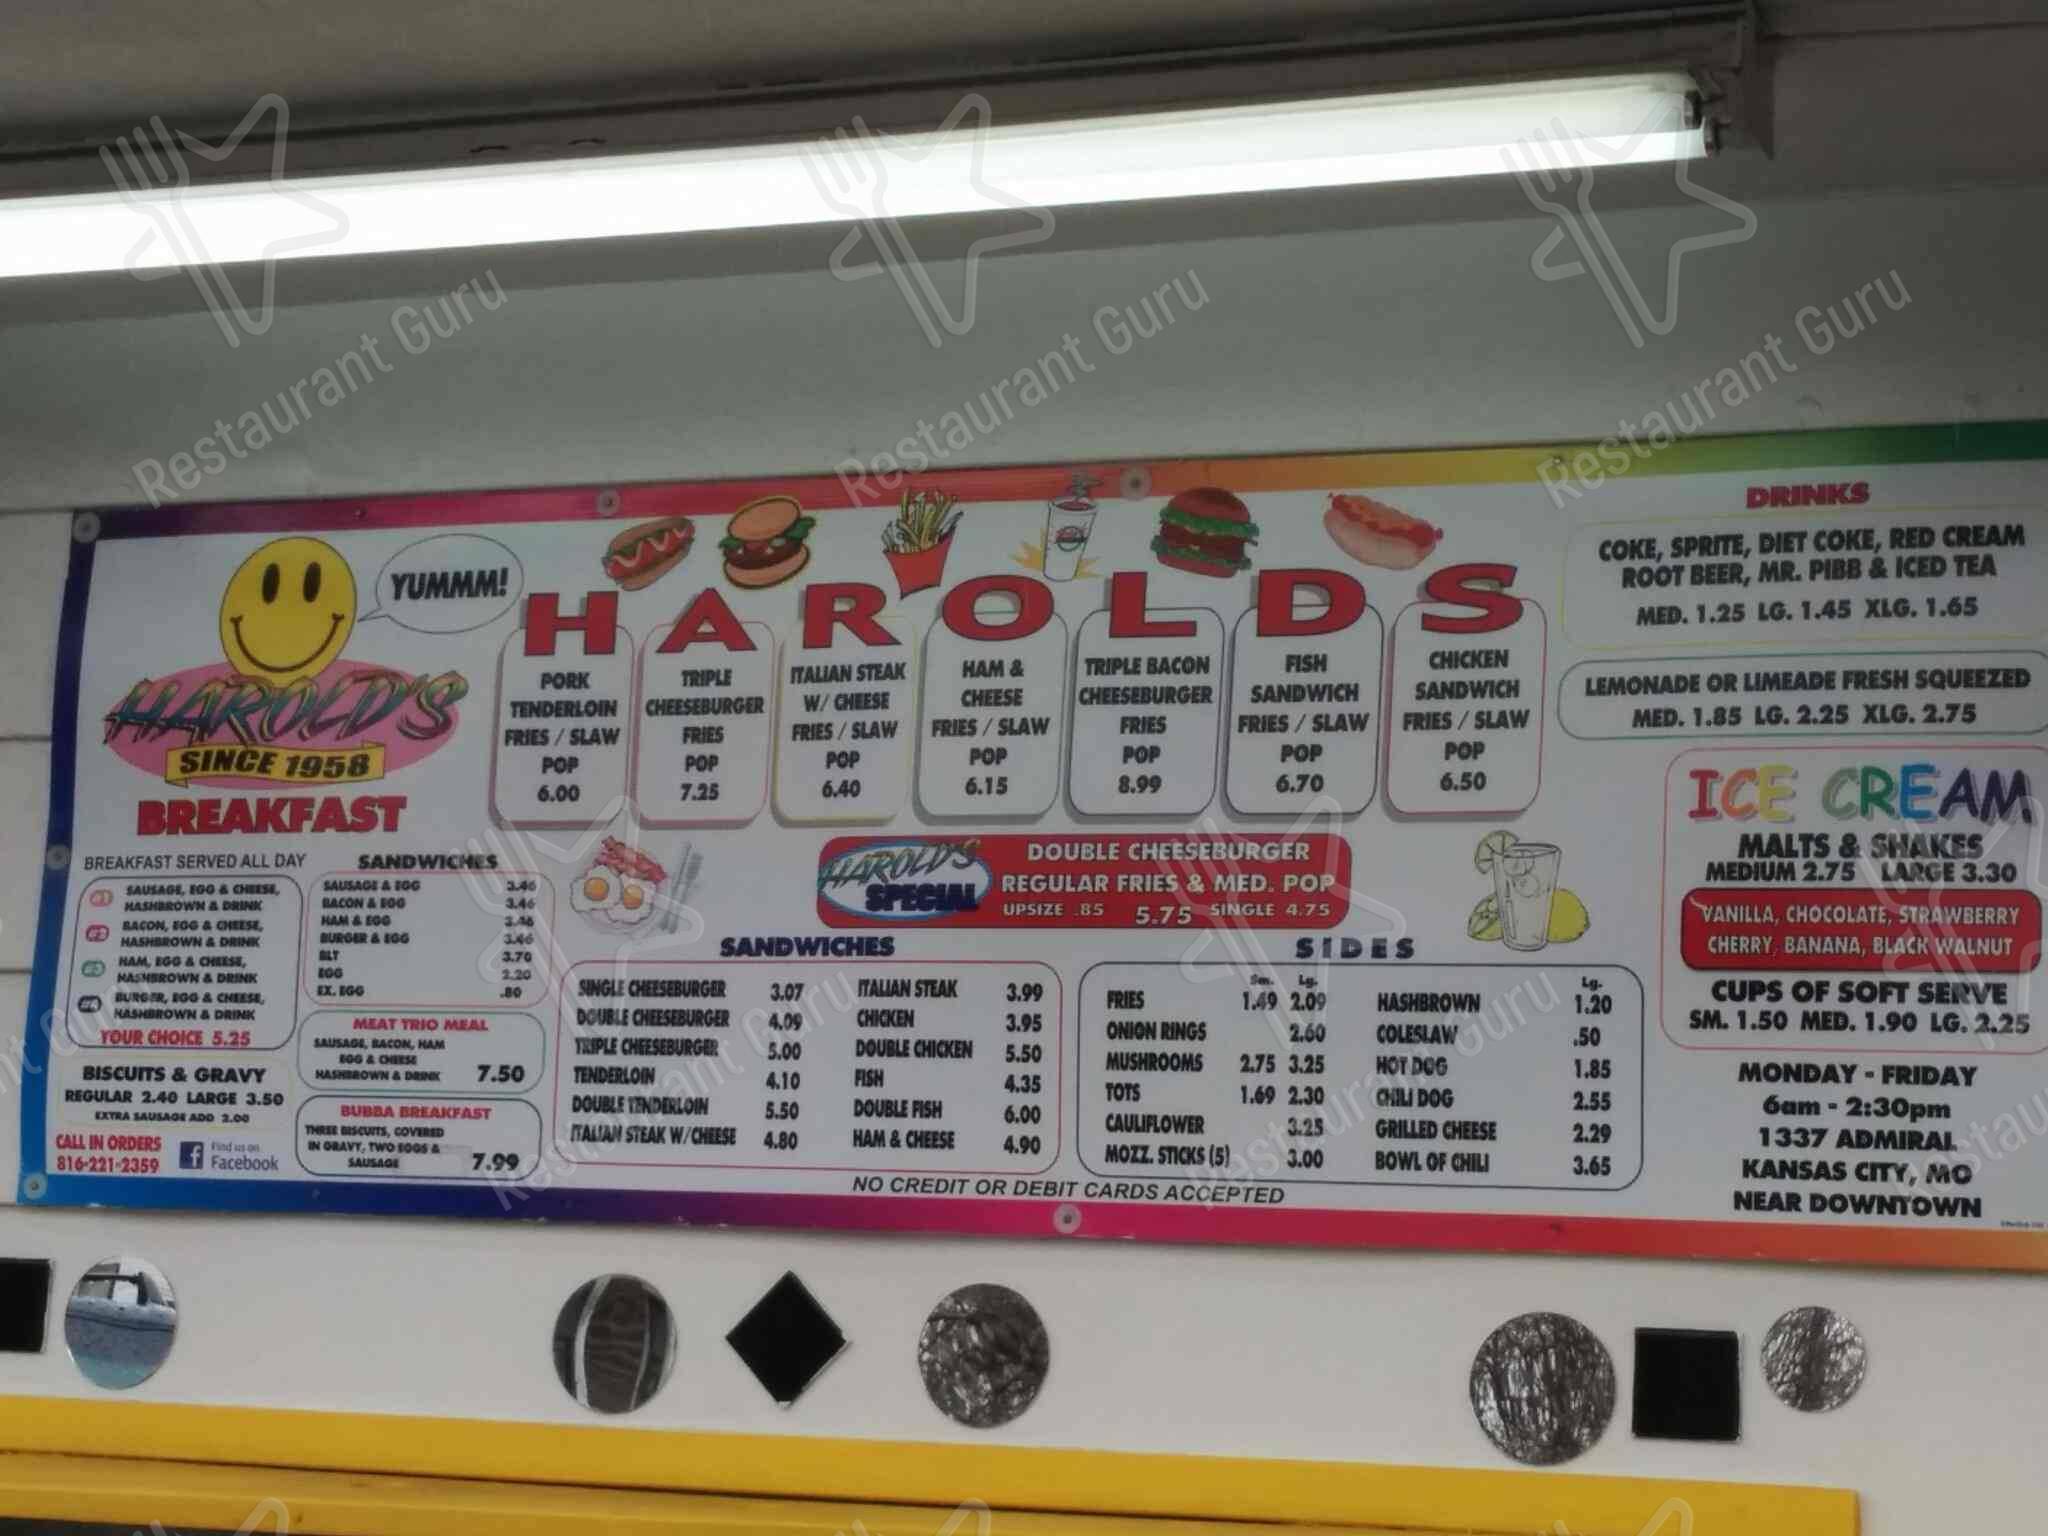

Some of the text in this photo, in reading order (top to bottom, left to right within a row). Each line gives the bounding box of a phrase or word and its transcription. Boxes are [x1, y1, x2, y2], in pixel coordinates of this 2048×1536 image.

[1746, 481, 1870, 509] DRINKS
[1599, 523, 2025, 563] COKE, SPRITE, DIET COKE, RED CREAM
[1622, 554, 1996, 589] ROOT BEER, MR. PIBB & ICED TEA
[391, 567, 509, 601] YUMMM!
[1636, 596, 1979, 626] MED. 1.25 LG. 1.45 XLG. 1.65
[962, 660, 1024, 678] HAM &
[1084, 656, 1210, 676] TRIPLE BACON
[1285, 654, 1327, 673] FISH
[1429, 650, 1510, 670] CHICKEN
[540, 672, 590, 690] PORK
[682, 669, 732, 687] TRIPLE
[790, 662, 906, 684] ITALIAN STEAK
[1585, 667, 2031, 697] LEMONADE OR LIMEADE FRESH SQUEEZED
[1251, 683, 1359, 703] SANDWICH
[1415, 680, 1520, 700] SANDWICH
[103, 671, 469, 745] HAROLD'S
[510, 699, 617, 718] TENDERLOIN
[646, 697, 765, 716] CHEESEBURGER
[179, 747, 371, 779] SINCE 1958
[680, 783, 719, 801] 7.25
[822, 780, 861, 798] 6.40
[965, 777, 1008, 795] 6.15
[1118, 775, 1162, 794] 8.99
[1276, 775, 1324, 793] 6.70
[1440, 773, 1487, 792] 6.50
[538, 784, 580, 803] 6.00
[1688, 764, 2033, 824] ICE CREAM
[137, 795, 407, 836] BREAKFAST
[1027, 842, 1310, 863] DOUBLE CHEESEBURGER
[1738, 833, 1983, 859] MALTS & SHAKES
[84, 853, 307, 870] BREAKFAST SERVED ALL DAY
[358, 855, 498, 869] SANDWICHES
[190, 885, 214, 895] EGG
[219, 885, 229, 895] &
[324, 881, 420, 891] SAUSAGE & EGG
[1002, 874, 1335, 893] REGULAR FRIES & MED. POP
[866, 883, 980, 913] SPECIAL
[1003, 903, 1103, 917] UPSIZE .85
[1135, 906, 1191, 925] 5.75
[1702, 905, 2020, 926] VANILLA, CHOCOLATE, STRAWBERRY
[502, 951, 531, 962] 3.70
[720, 937, 895, 958] SANDWICHES
[1295, 937, 1415, 959] SIDES
[579, 980, 804, 1001] SINGLE CHEESEBURGER 3.07
[858, 979, 1043, 1002] ITALIAN STEAK 3.99
[1711, 981, 2008, 1005] CUPS OF SOFT SERVE
[1378, 993, 1612, 1014] HASHBROWN 1.20
[353, 1019, 488, 1031] MEAT TRIO MEAL
[857, 1009, 1041, 1032] CHICKEN 3.95
[100, 1029, 250, 1046] YOUR CHOICE 5.25
[477, 1065, 524, 1082] 7.50
[1106, 1053, 1324, 1074] MUSHROOMS 2.75 3.25
[83, 1066, 266, 1083] BISCUITS & GRAVY
[1738, 1062, 1978, 1087] MONDAY FRIDAY
[65, 1091, 284, 1105] REGULAR 2.40 LARGE 3.50
[341, 1105, 492, 1119] BUBBA BREAKFAST
[1763, 1096, 1951, 1122] 6am 2:30pm
[1376, 1120, 1611, 1143] GRILLED CHEESE 2.29
[1760, 1128, 1827, 1148] 1337
[56, 1134, 161, 1151] CALL IN ORDERS
[57, 1156, 159, 1173] 816-221-2359
[212, 1156, 278, 1171] Facebook
[472, 1153, 519, 1170] 7.99
[1742, 1159, 1972, 1186] KANSAS CITY, MO
[852, 1176, 1285, 1204] NO CREDIT OR DEBIT CARDS ACCEPTED
[1733, 1190, 1982, 1218] NEAR DOWNTOWN
